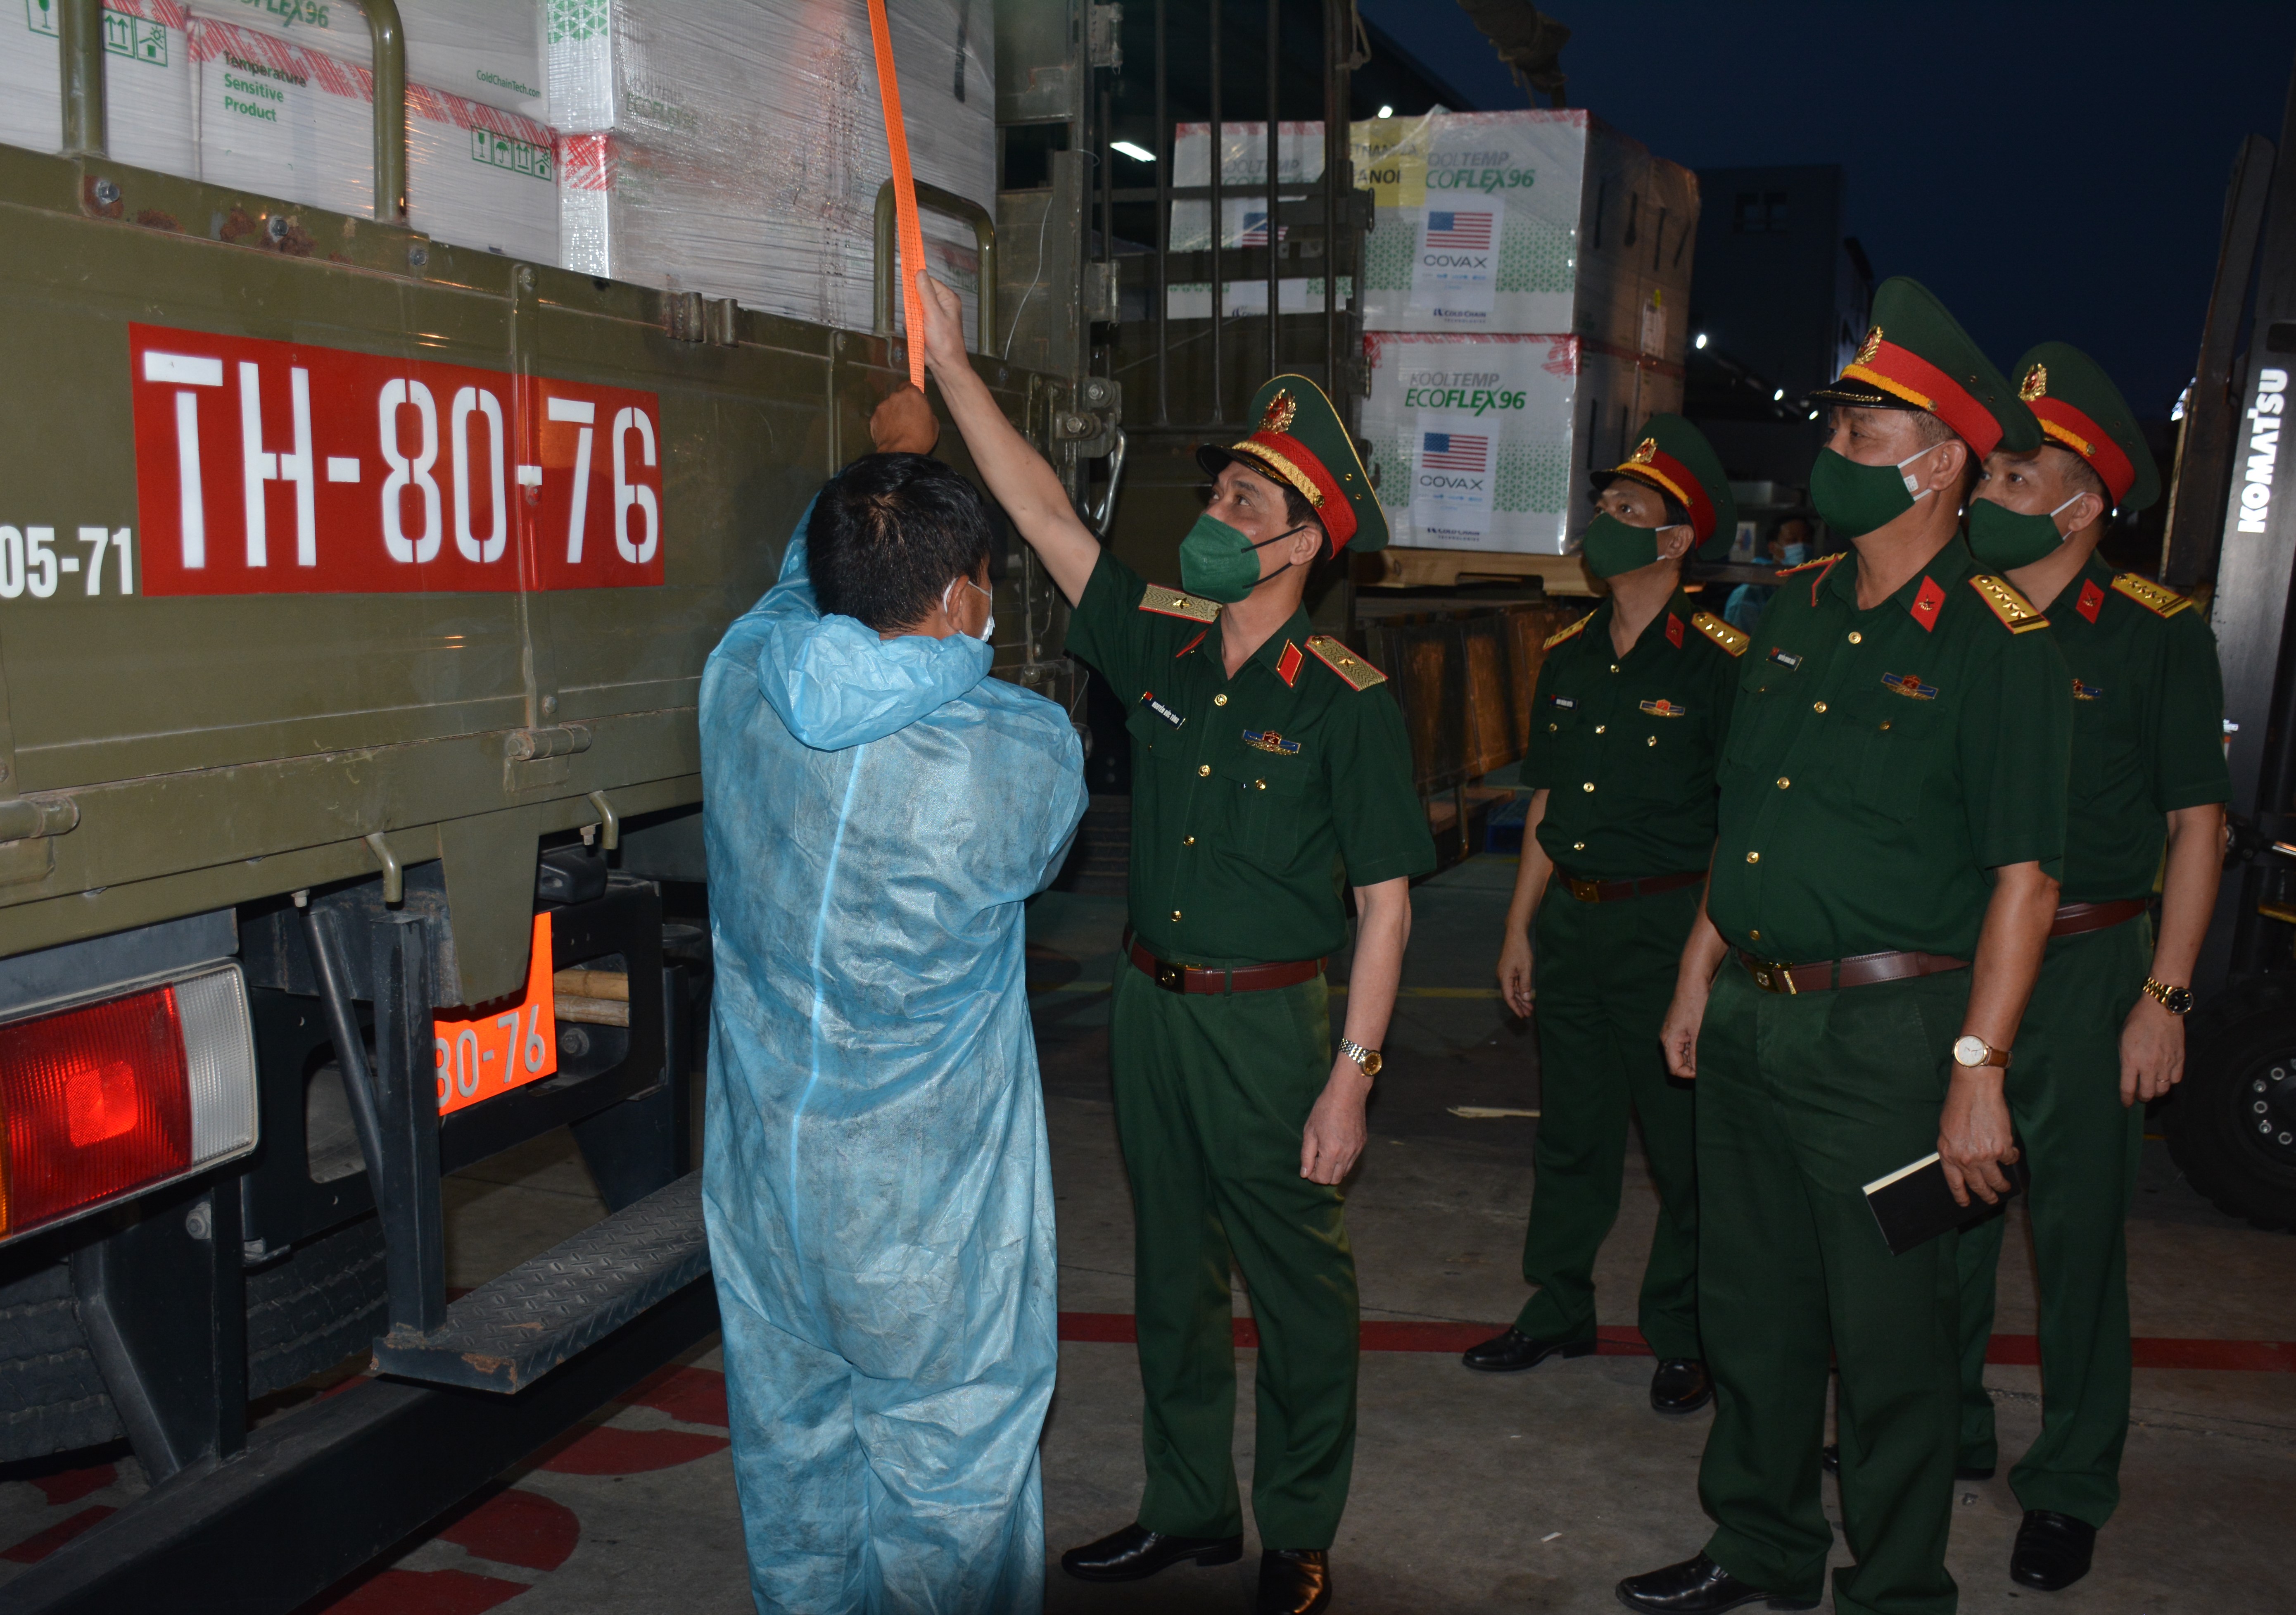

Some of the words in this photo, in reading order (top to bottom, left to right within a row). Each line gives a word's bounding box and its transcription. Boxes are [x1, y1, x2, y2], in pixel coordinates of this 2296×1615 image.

[223, 49, 306, 88] Temperature
[225, 73, 284, 102] Sensitive
[477, 69, 541, 99] ColdChainTech.com
[225, 95, 277, 122] Product
[1427, 151, 1510, 166] OOLTEMP
[1356, 168, 1401, 184] ANOI
[1426, 165, 1536, 194] COFLEX96
[1424, 254, 1488, 268] COVAX
[1409, 372, 1500, 387] KOOLTEMP
[1405, 386, 1527, 417] ECOFLEX96
[145, 351, 658, 568] TH-80-76
[2238, 369, 2288, 533] KOMATSU
[1420, 476, 1484, 491] COVAX
[0, 526, 133, 598] 05-71
